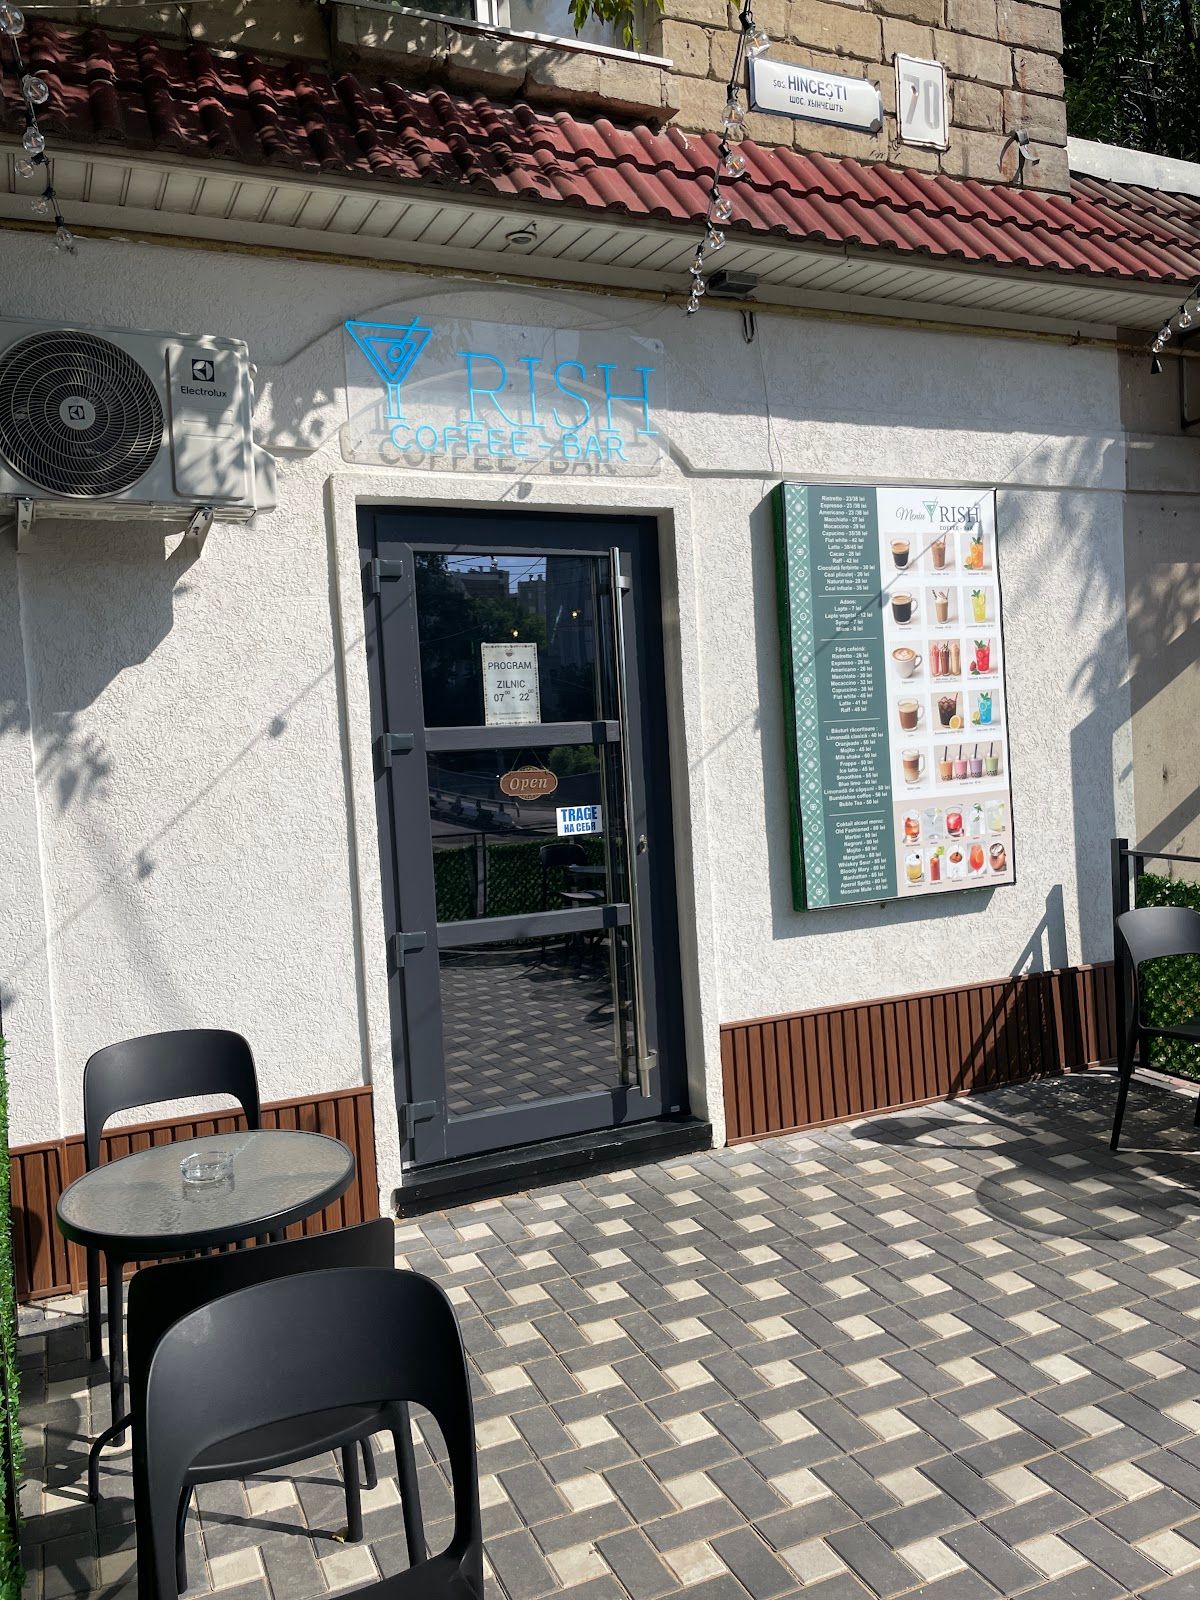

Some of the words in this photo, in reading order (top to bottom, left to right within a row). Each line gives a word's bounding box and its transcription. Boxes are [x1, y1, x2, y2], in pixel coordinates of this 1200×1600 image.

[904, 74, 940, 130] 70
[181, 386, 227, 397] Electrolux
[488, 662, 532, 670] PROGRAM
[497, 680, 526, 688] ZILNIC
[510, 777, 548, 790] Open
[561, 807, 597, 822] TRAGE
[564, 824, 574, 833] НА
[576, 822, 595, 832] СЕБЯ
